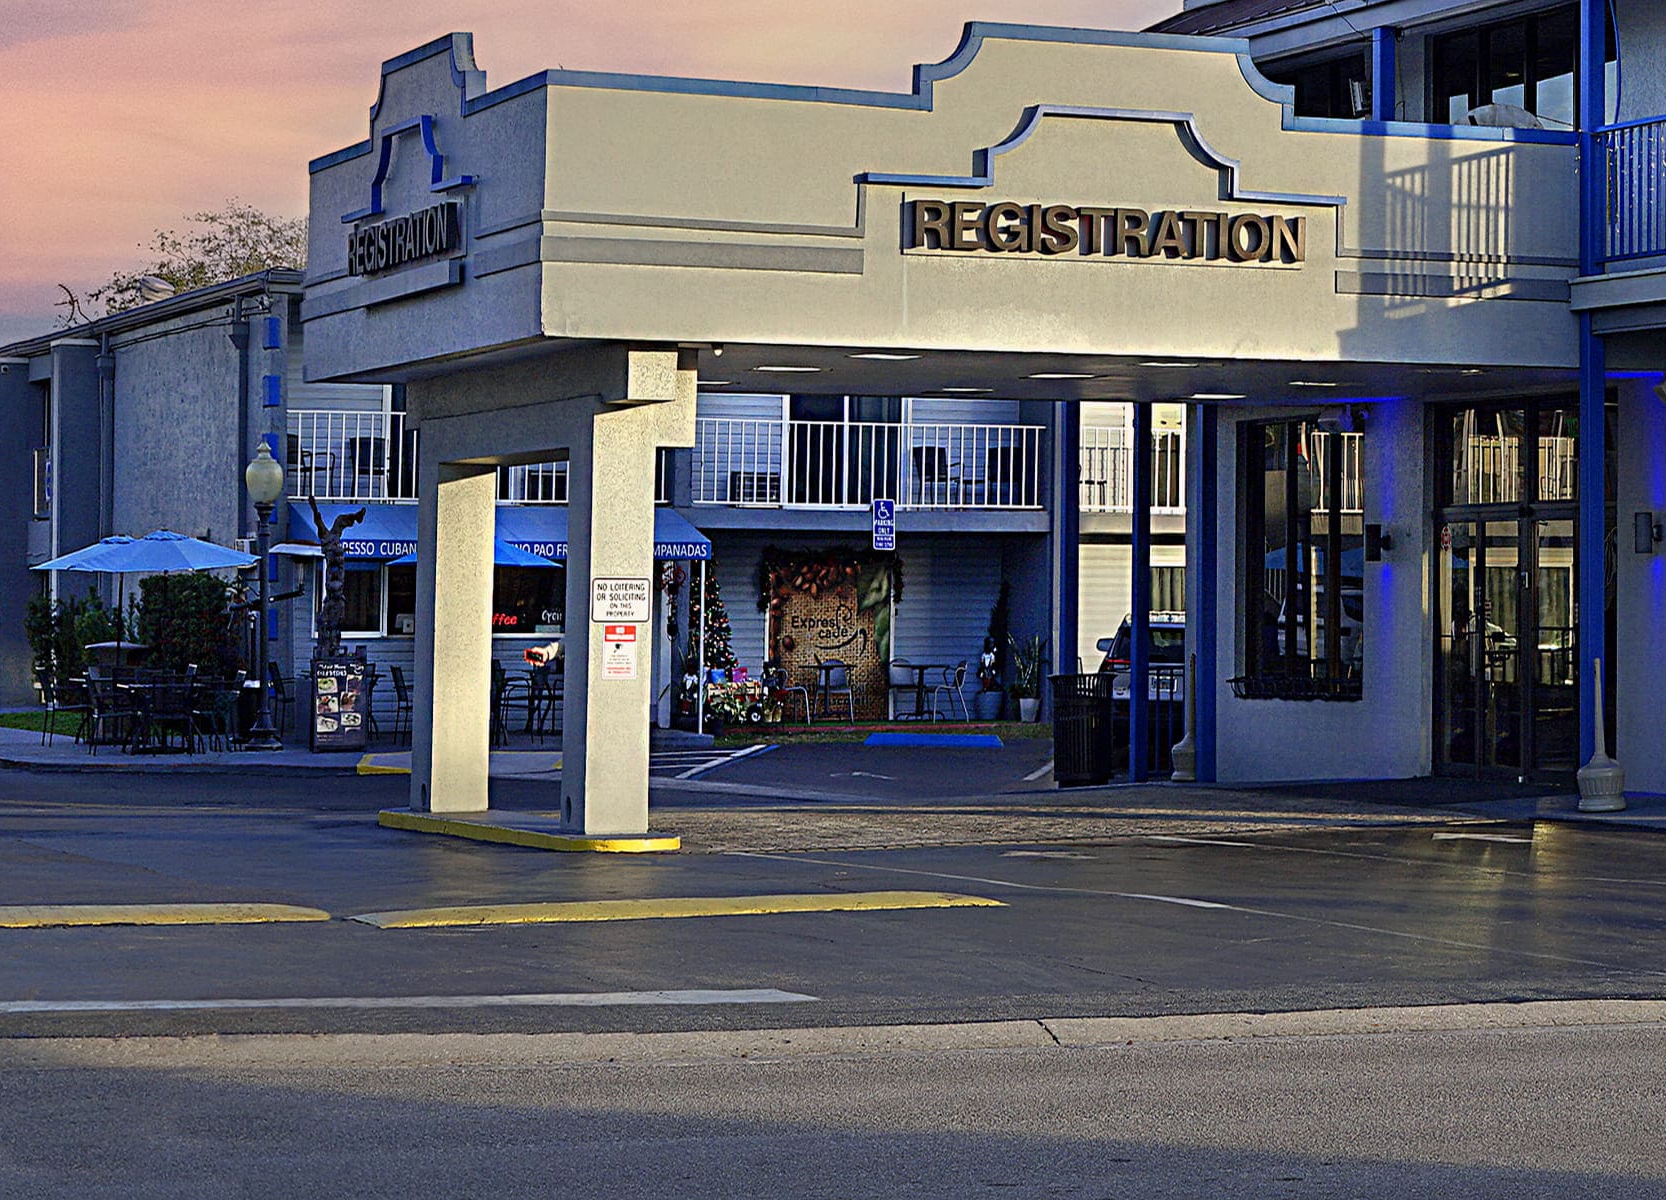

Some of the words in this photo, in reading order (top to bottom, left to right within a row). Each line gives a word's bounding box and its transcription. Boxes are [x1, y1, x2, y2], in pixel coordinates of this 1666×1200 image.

[913, 200, 1306, 263] REGISTRATION
[348, 202, 450, 277] REGISTRATION
[534, 543, 554, 556] PAO
[597, 583, 608, 591] NO
[610, 583, 645, 591] LOITERING
[596, 592, 606, 601] OR
[609, 592, 646, 601] SOLICITING
